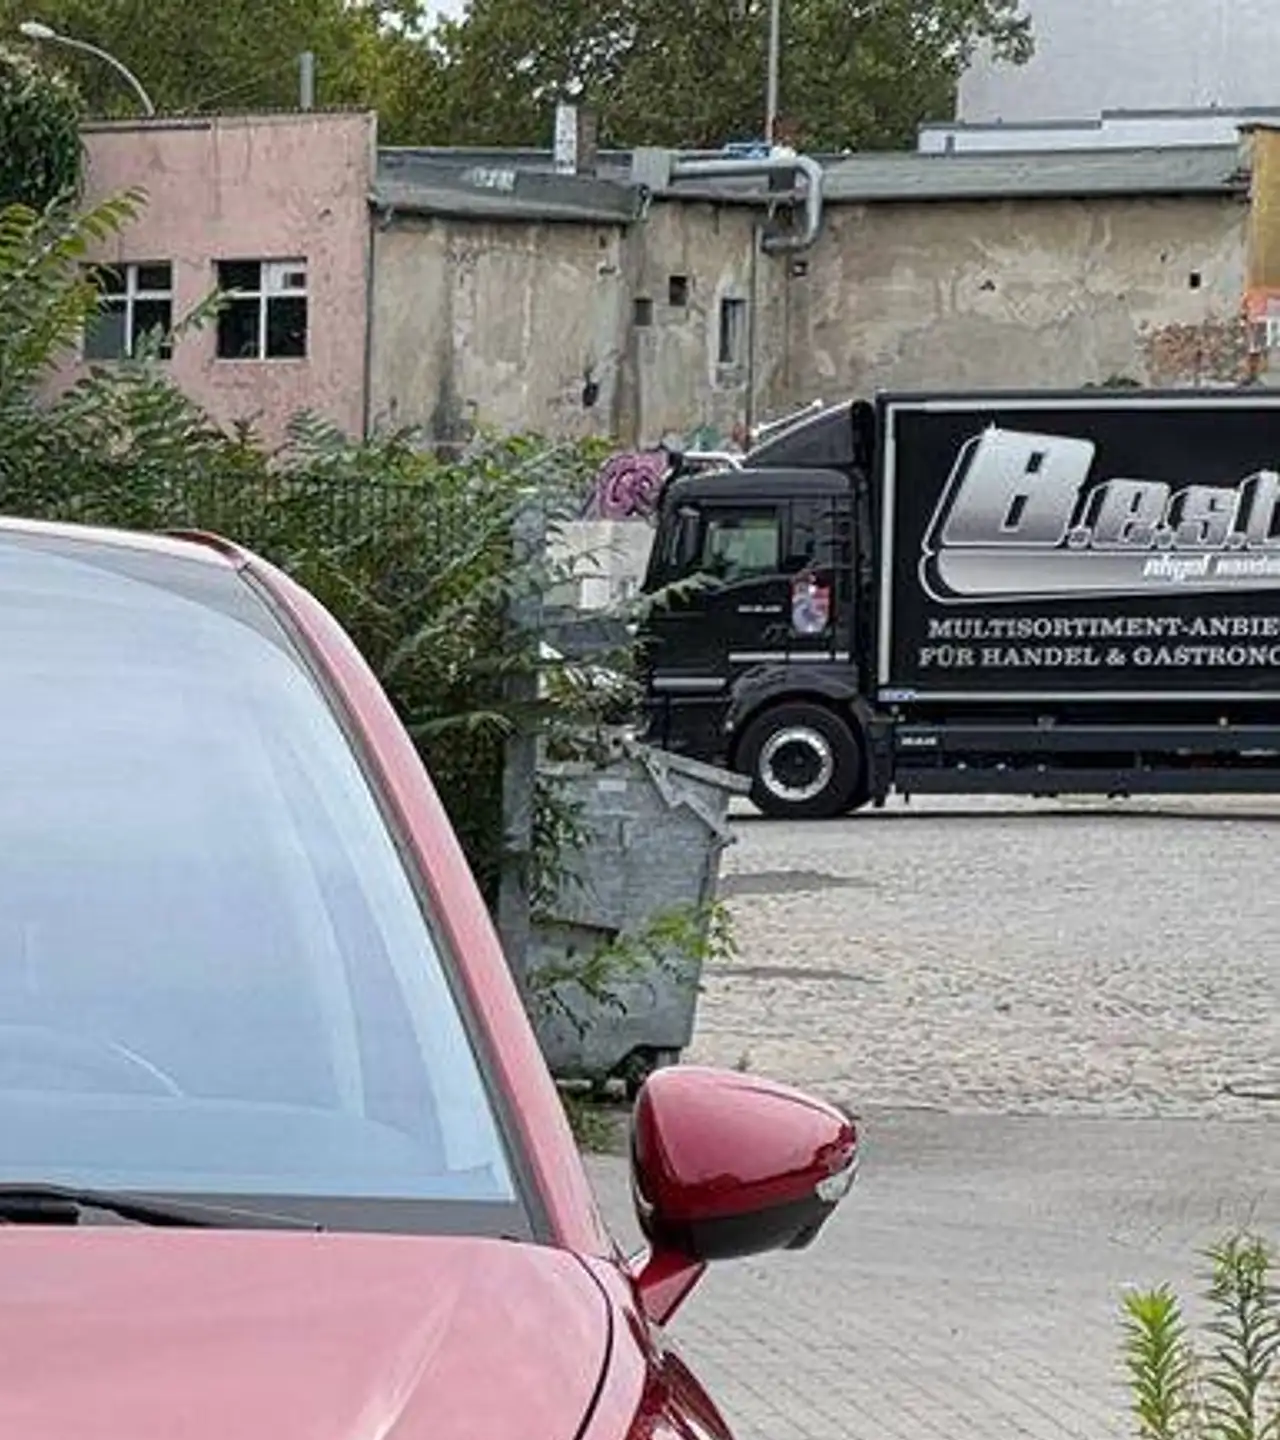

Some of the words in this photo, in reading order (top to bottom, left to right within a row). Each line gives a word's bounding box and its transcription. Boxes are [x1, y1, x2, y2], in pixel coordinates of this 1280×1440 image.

[918, 644, 975, 668] FÜR
[981, 646, 1101, 666] HANDEL
[1105, 647, 1127, 666] &
